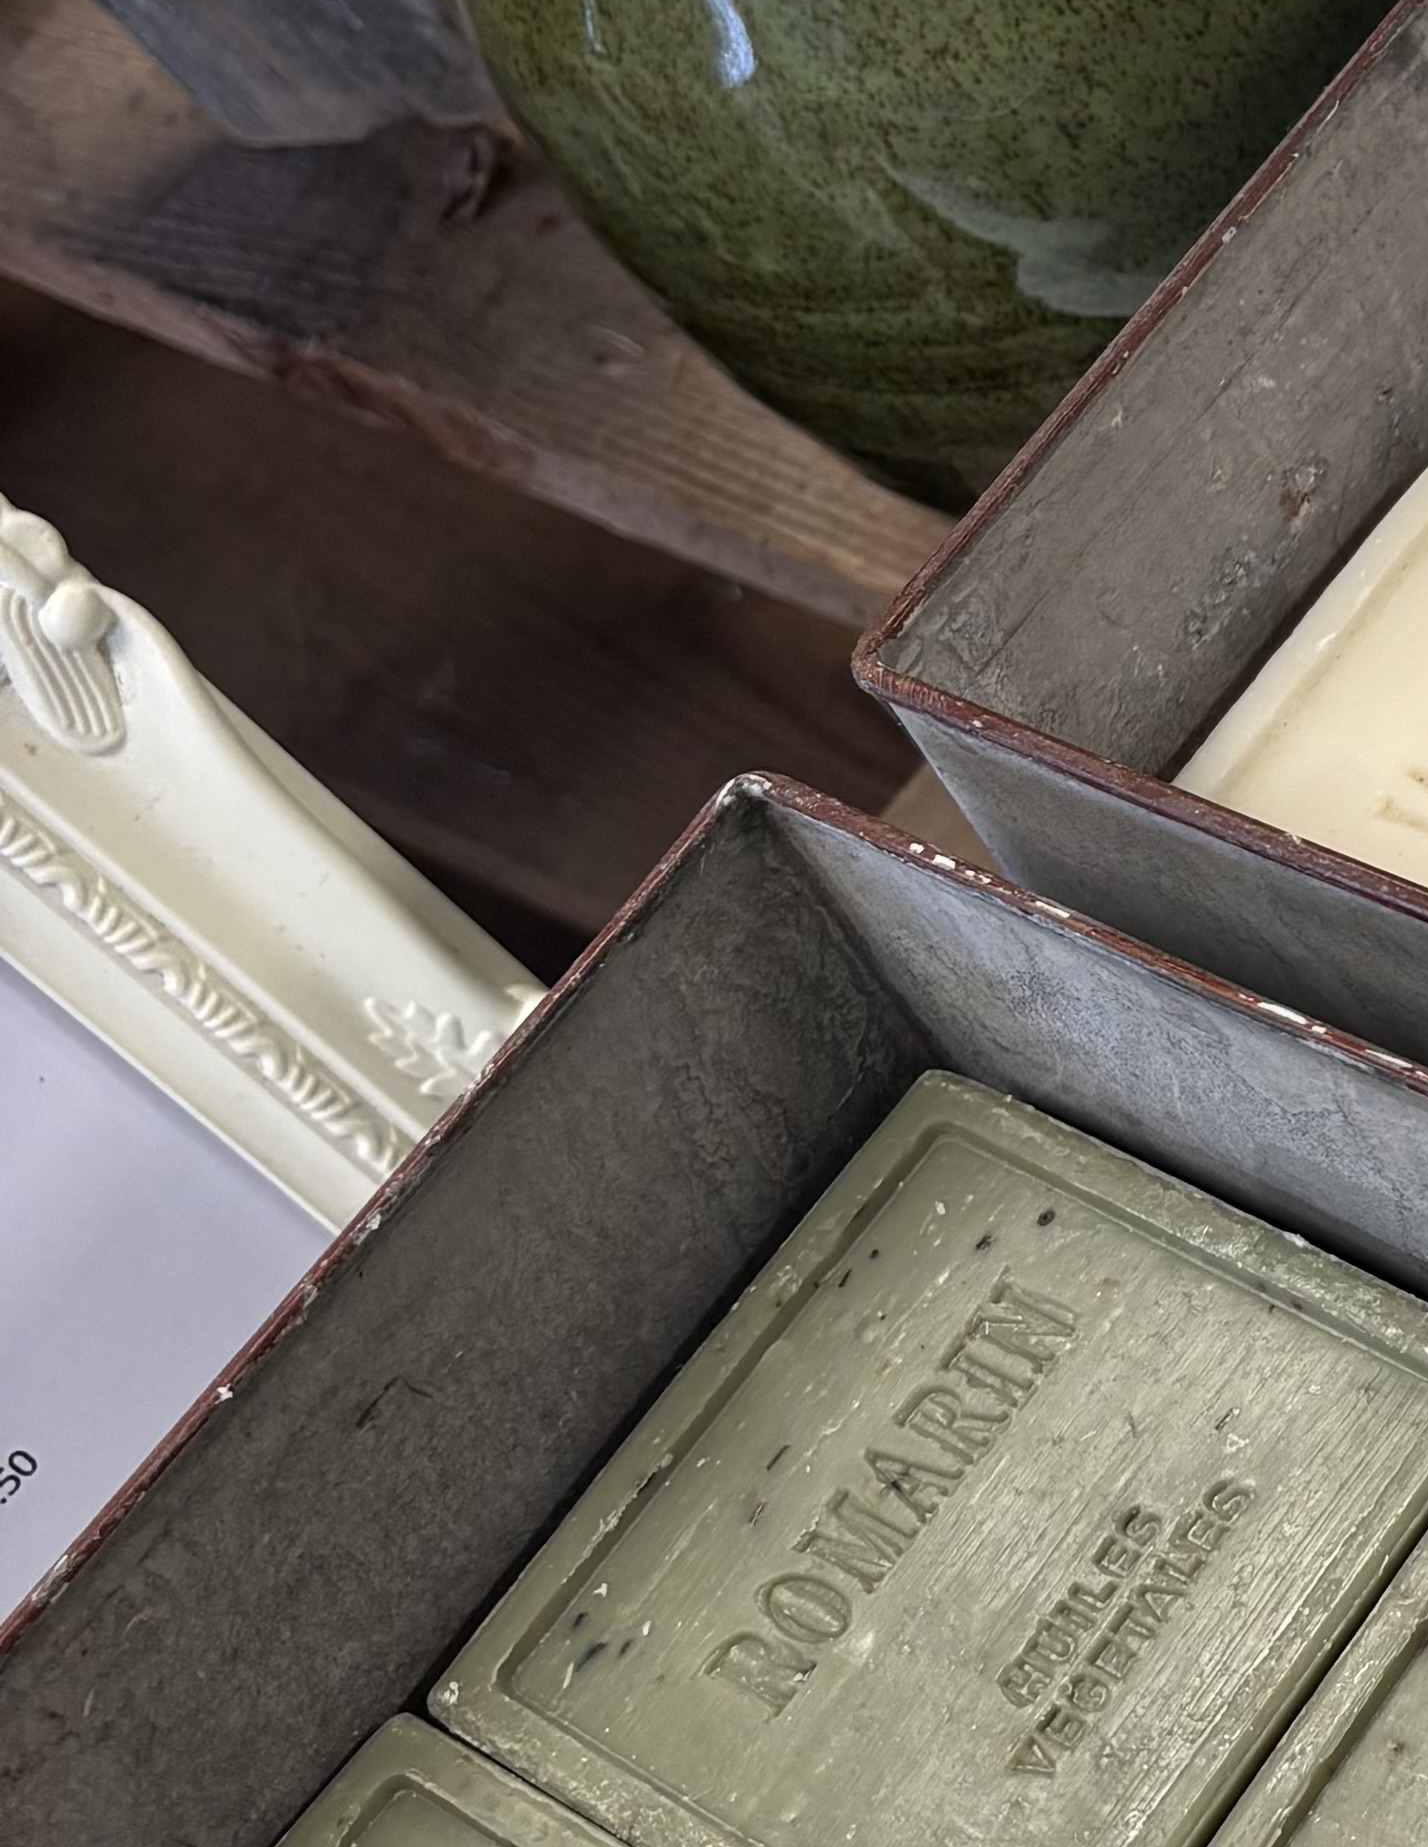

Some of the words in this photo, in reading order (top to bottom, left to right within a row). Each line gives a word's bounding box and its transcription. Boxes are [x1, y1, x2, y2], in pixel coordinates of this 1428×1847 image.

[699, 1267, 1078, 1719] ROMARIN
[1000, 1503, 1164, 1711] HUILES
[1007, 1477, 1259, 1782] VEGETALES
